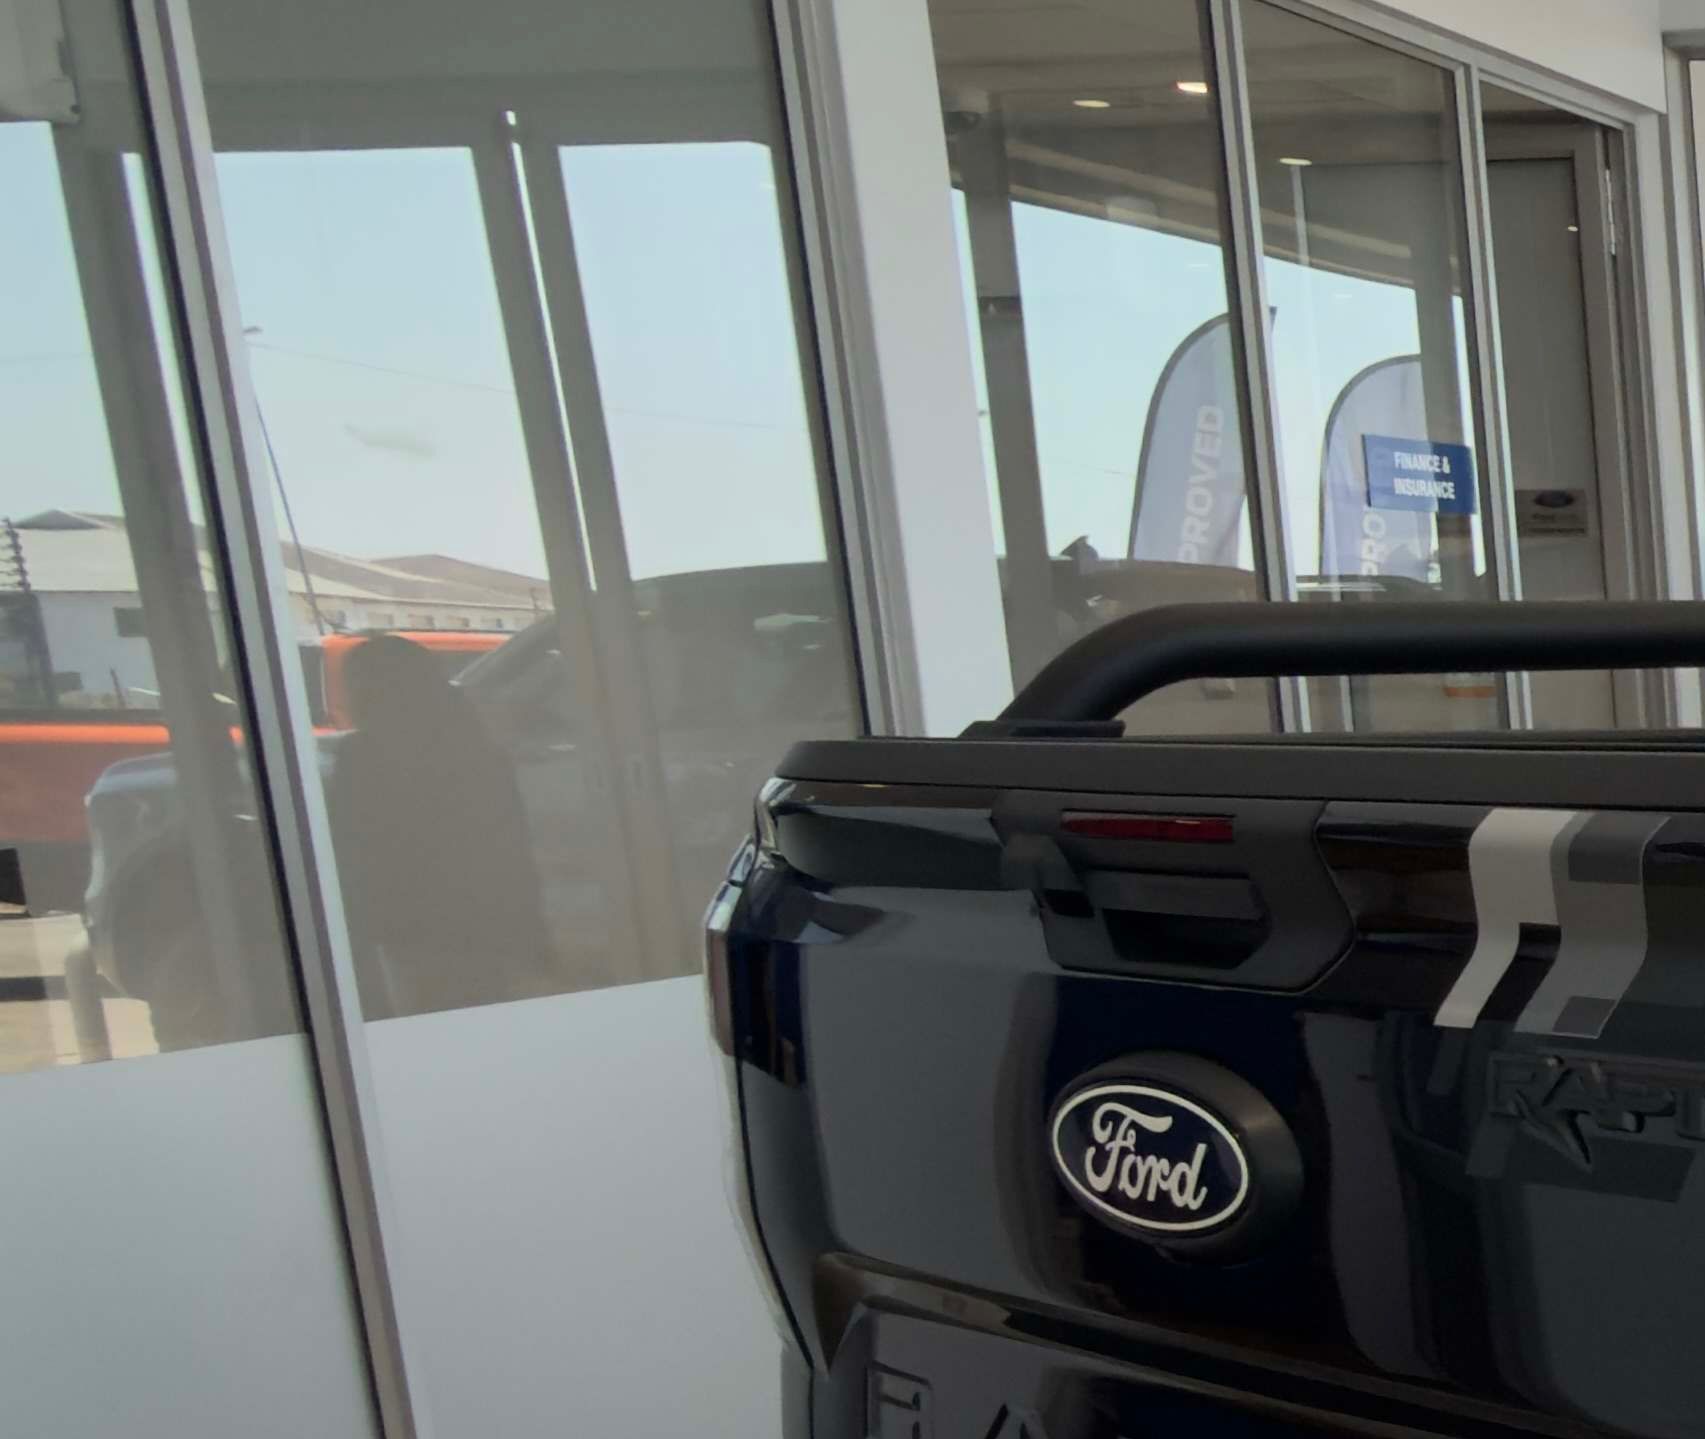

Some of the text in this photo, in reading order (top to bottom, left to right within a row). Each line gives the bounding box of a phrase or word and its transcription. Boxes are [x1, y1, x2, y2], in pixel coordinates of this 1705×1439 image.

[1393, 451, 1451, 474] FINANCE &
[1393, 477, 1456, 500] INSURANCE
[1084, 1101, 1211, 1212] Ford
